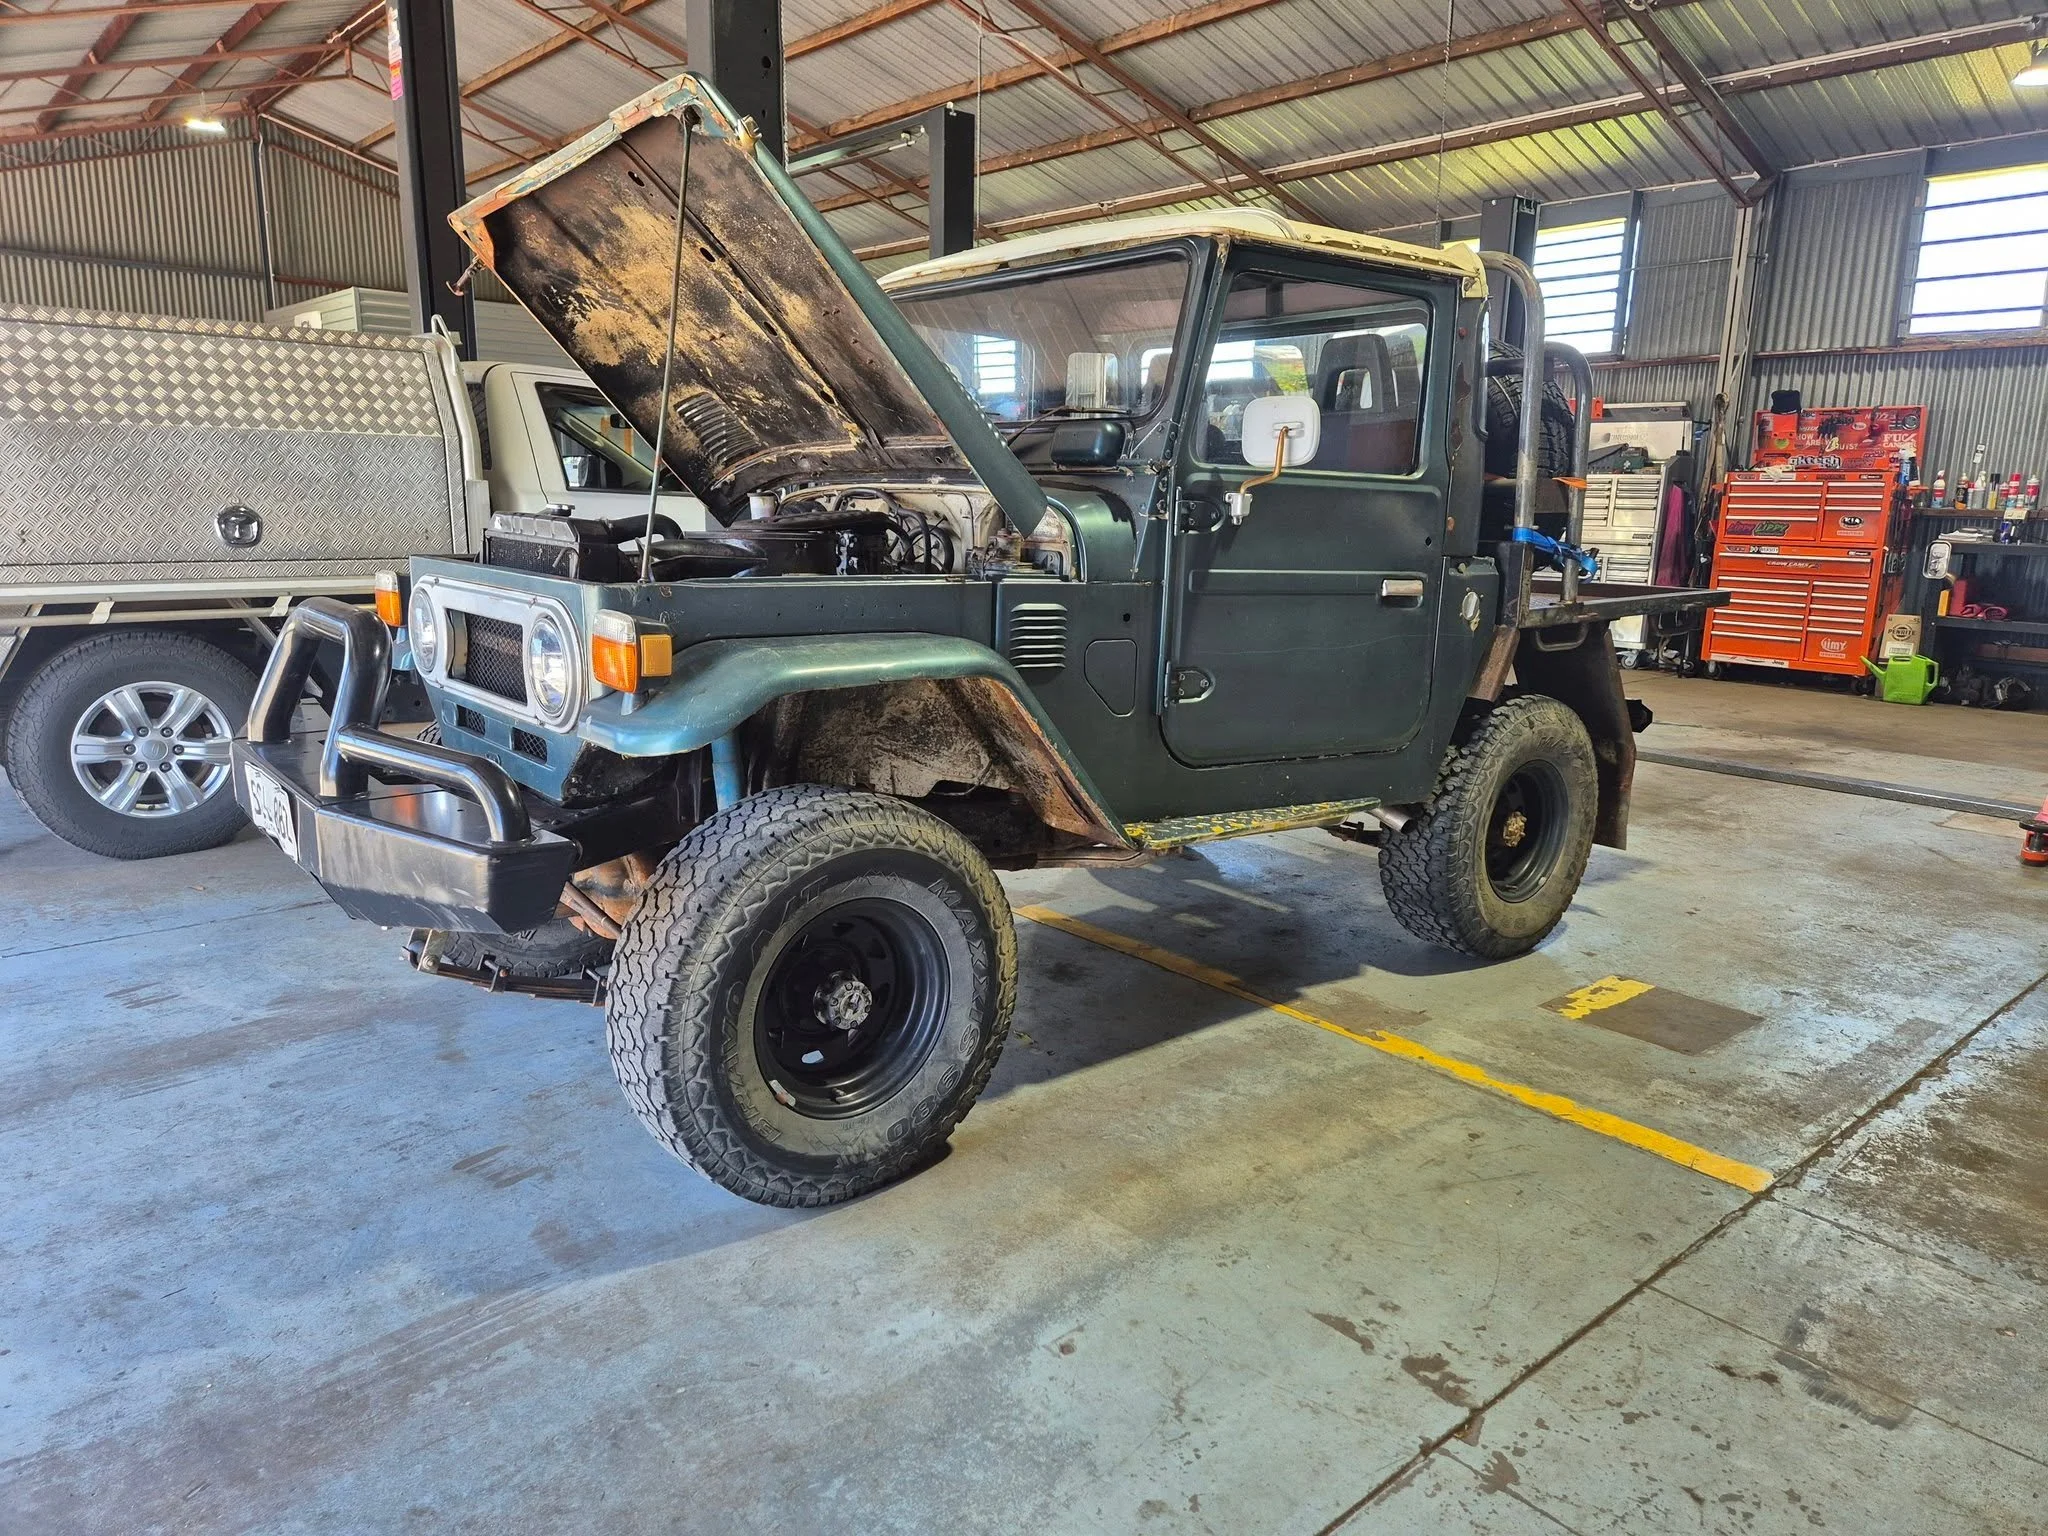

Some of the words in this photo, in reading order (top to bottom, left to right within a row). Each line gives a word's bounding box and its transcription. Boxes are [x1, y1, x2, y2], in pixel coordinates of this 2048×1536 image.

[1887, 628, 1916, 636] PENRITE
[927, 878, 989, 1057] MAXXIS
[721, 980, 783, 1143] BRAVO
[886, 1063, 963, 1143] 980
